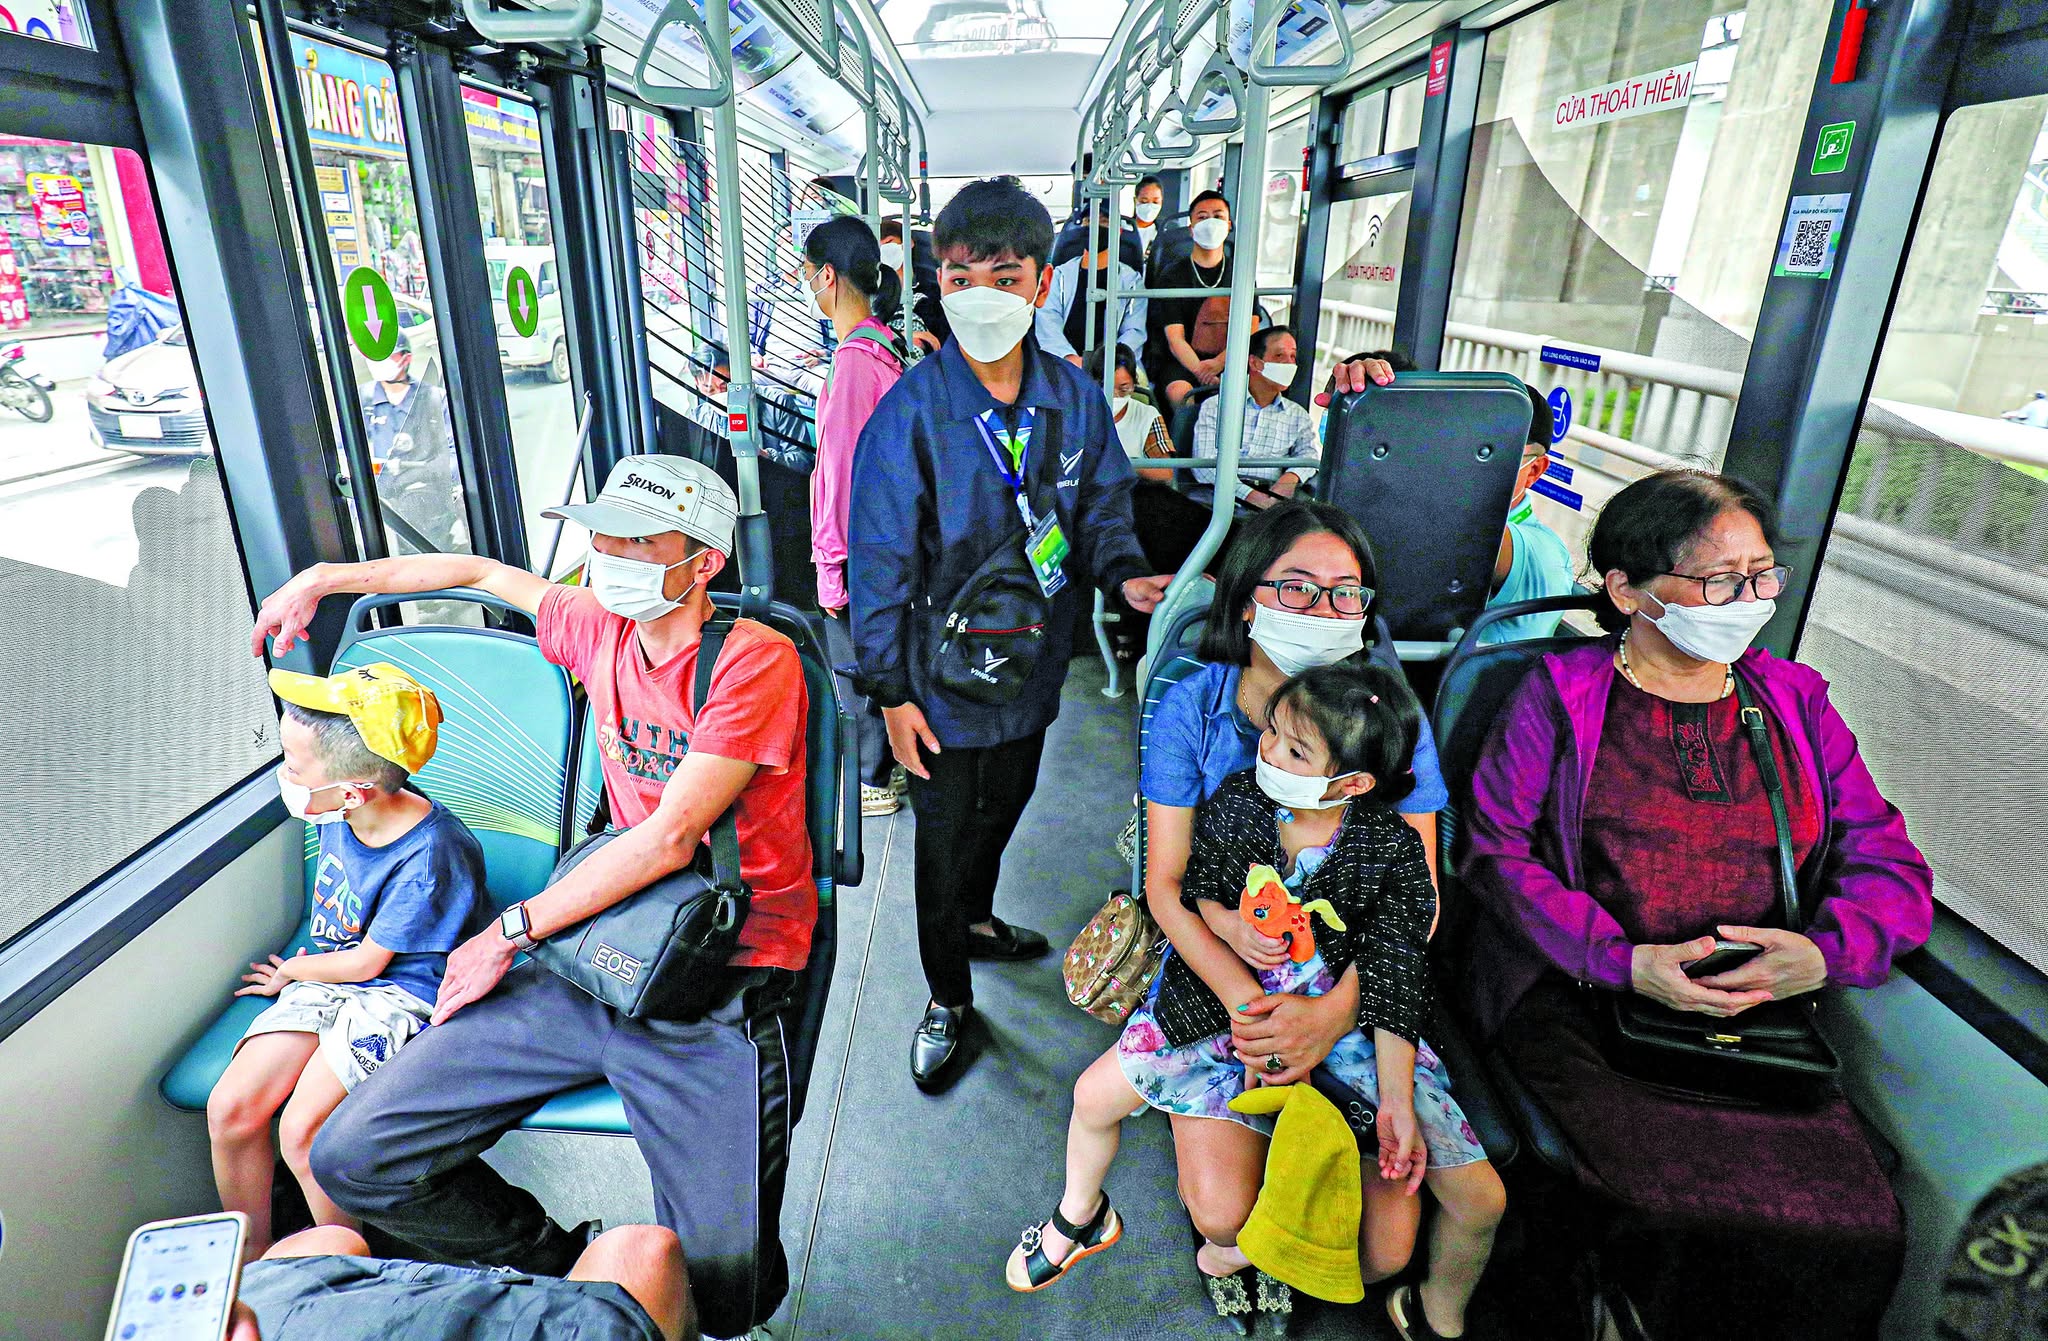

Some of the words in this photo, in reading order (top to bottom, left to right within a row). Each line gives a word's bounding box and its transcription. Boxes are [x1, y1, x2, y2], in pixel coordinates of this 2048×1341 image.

[364, 77, 405, 144] CÁ
[1556, 95, 1586, 125] CỬA
[1590, 80, 1642, 117] THOÁT
[1643, 69, 1691, 106] HIỂM
[619, 473, 675, 500] SRIXON
[971, 667, 998, 684] VINBUS
[594, 947, 639, 980] EOS
